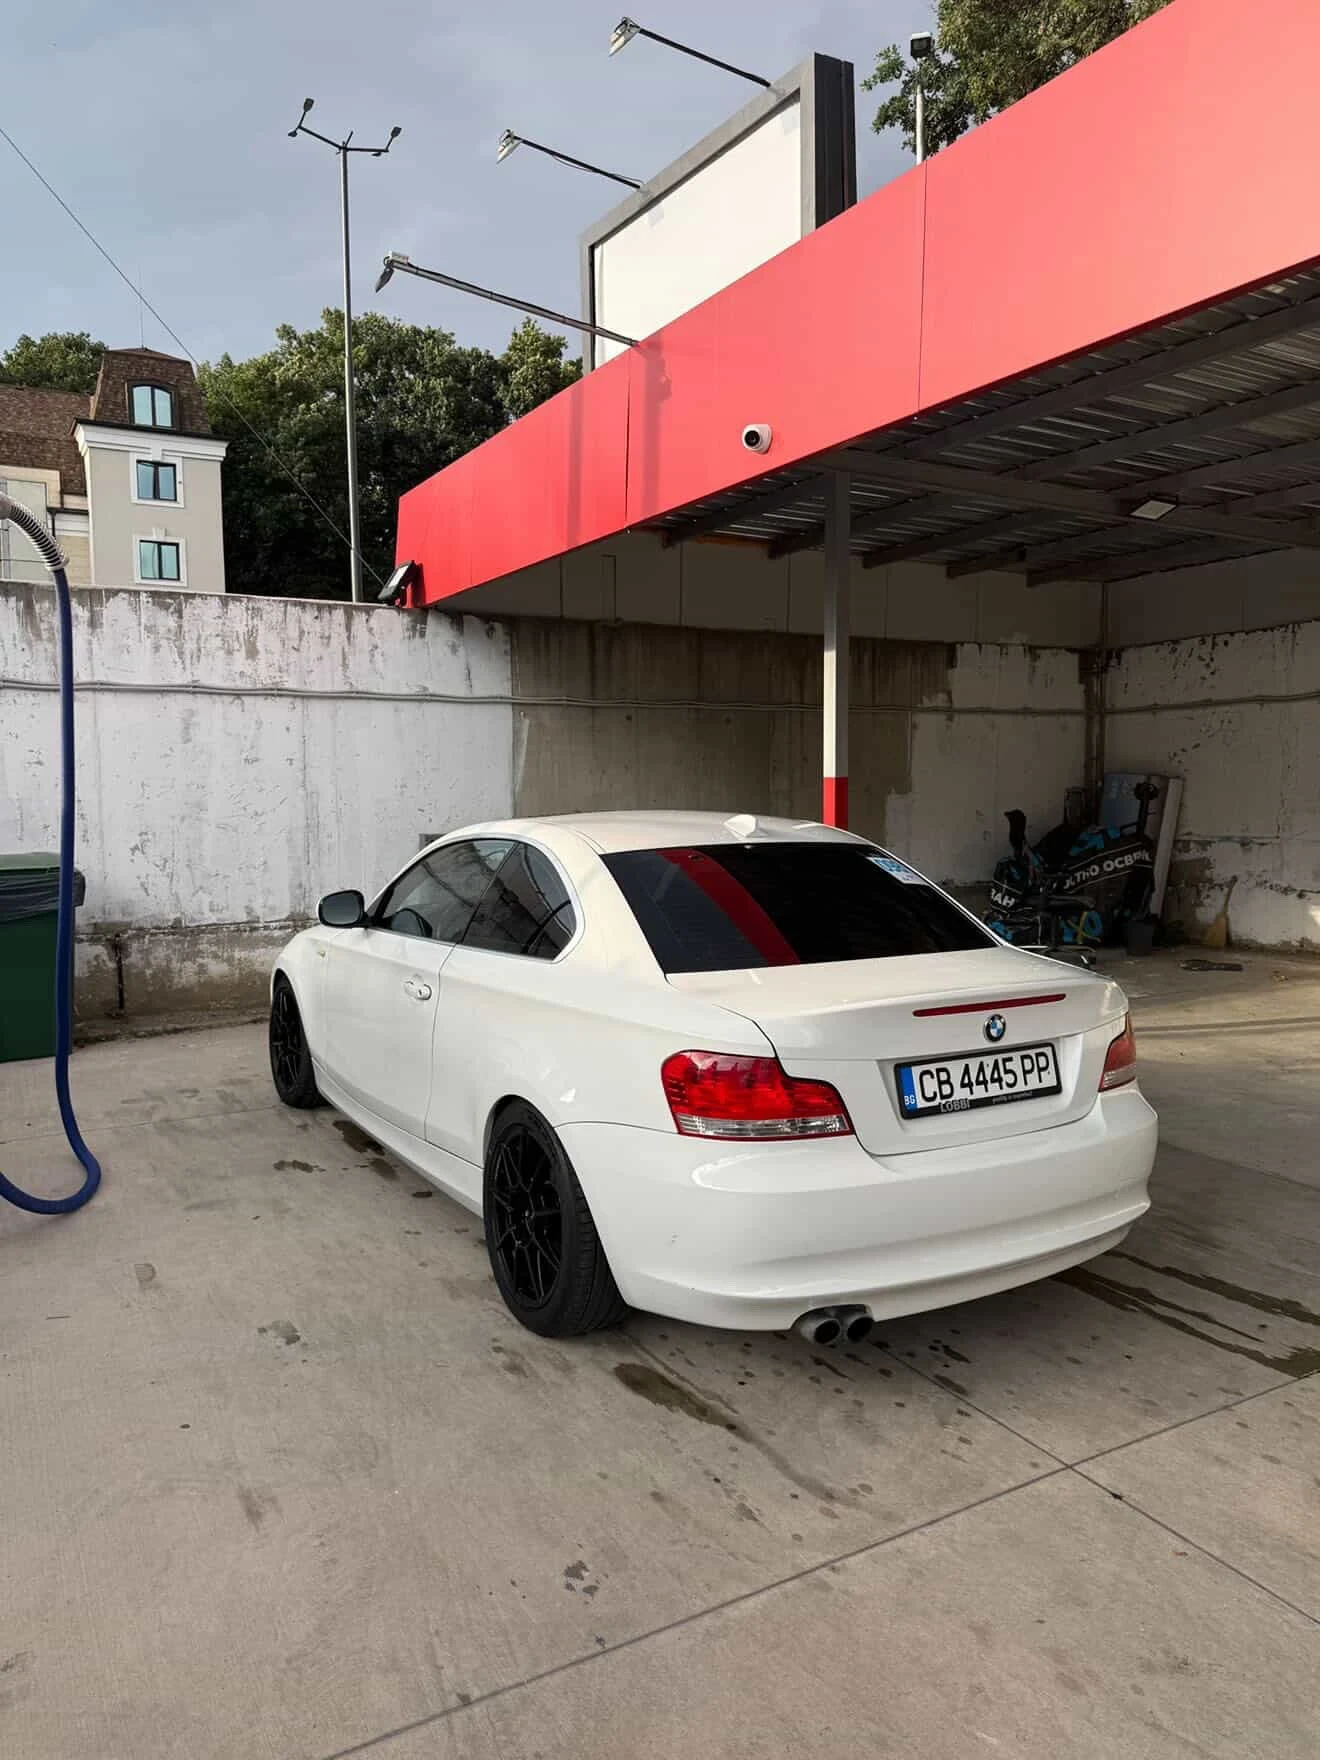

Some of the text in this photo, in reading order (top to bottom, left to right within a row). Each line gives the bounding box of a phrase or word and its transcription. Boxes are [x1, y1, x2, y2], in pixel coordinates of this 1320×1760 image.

[919, 1067, 954, 1102] CB
[960, 1057, 1018, 1095] 4445
[1020, 1051, 1050, 1086] PP
[904, 1095, 916, 1105] BG
